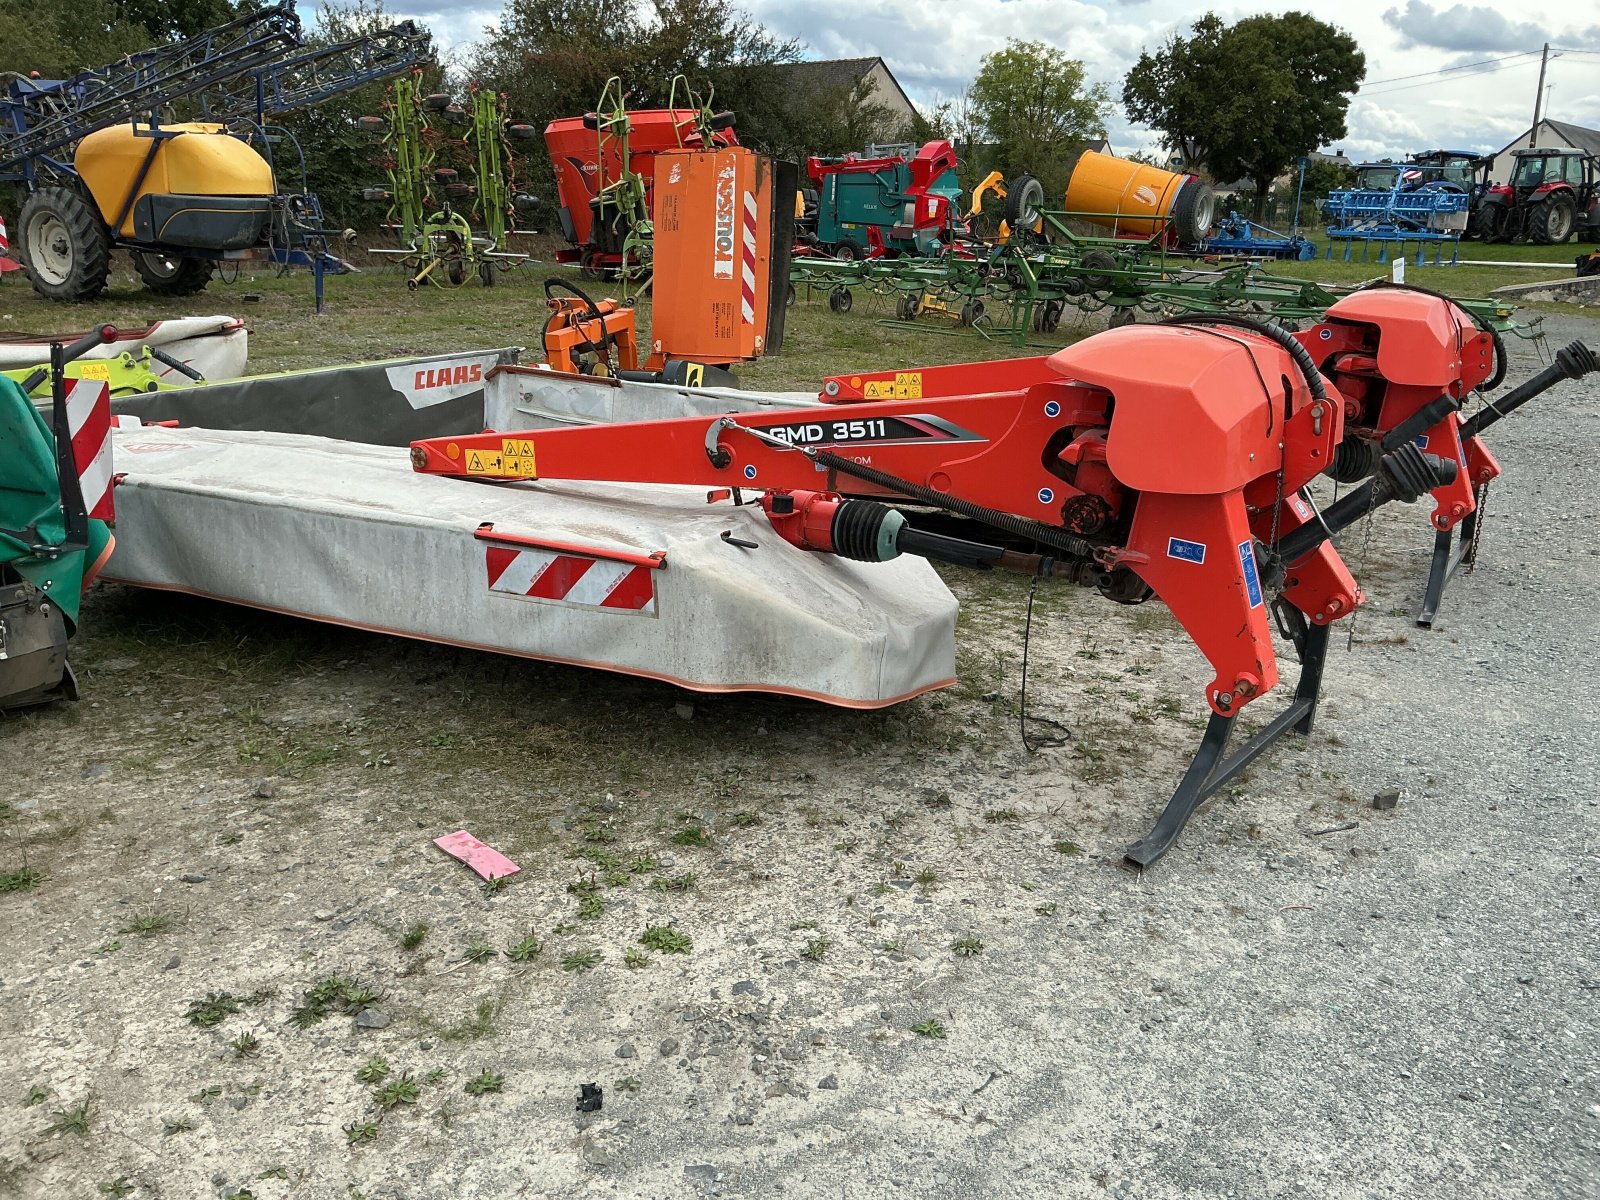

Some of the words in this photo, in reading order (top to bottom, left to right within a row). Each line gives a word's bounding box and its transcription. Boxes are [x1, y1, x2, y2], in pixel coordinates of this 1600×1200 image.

[415, 364, 482, 390] CLAAS
[769, 424, 824, 443] GMD
[832, 420, 886, 440] 3511
